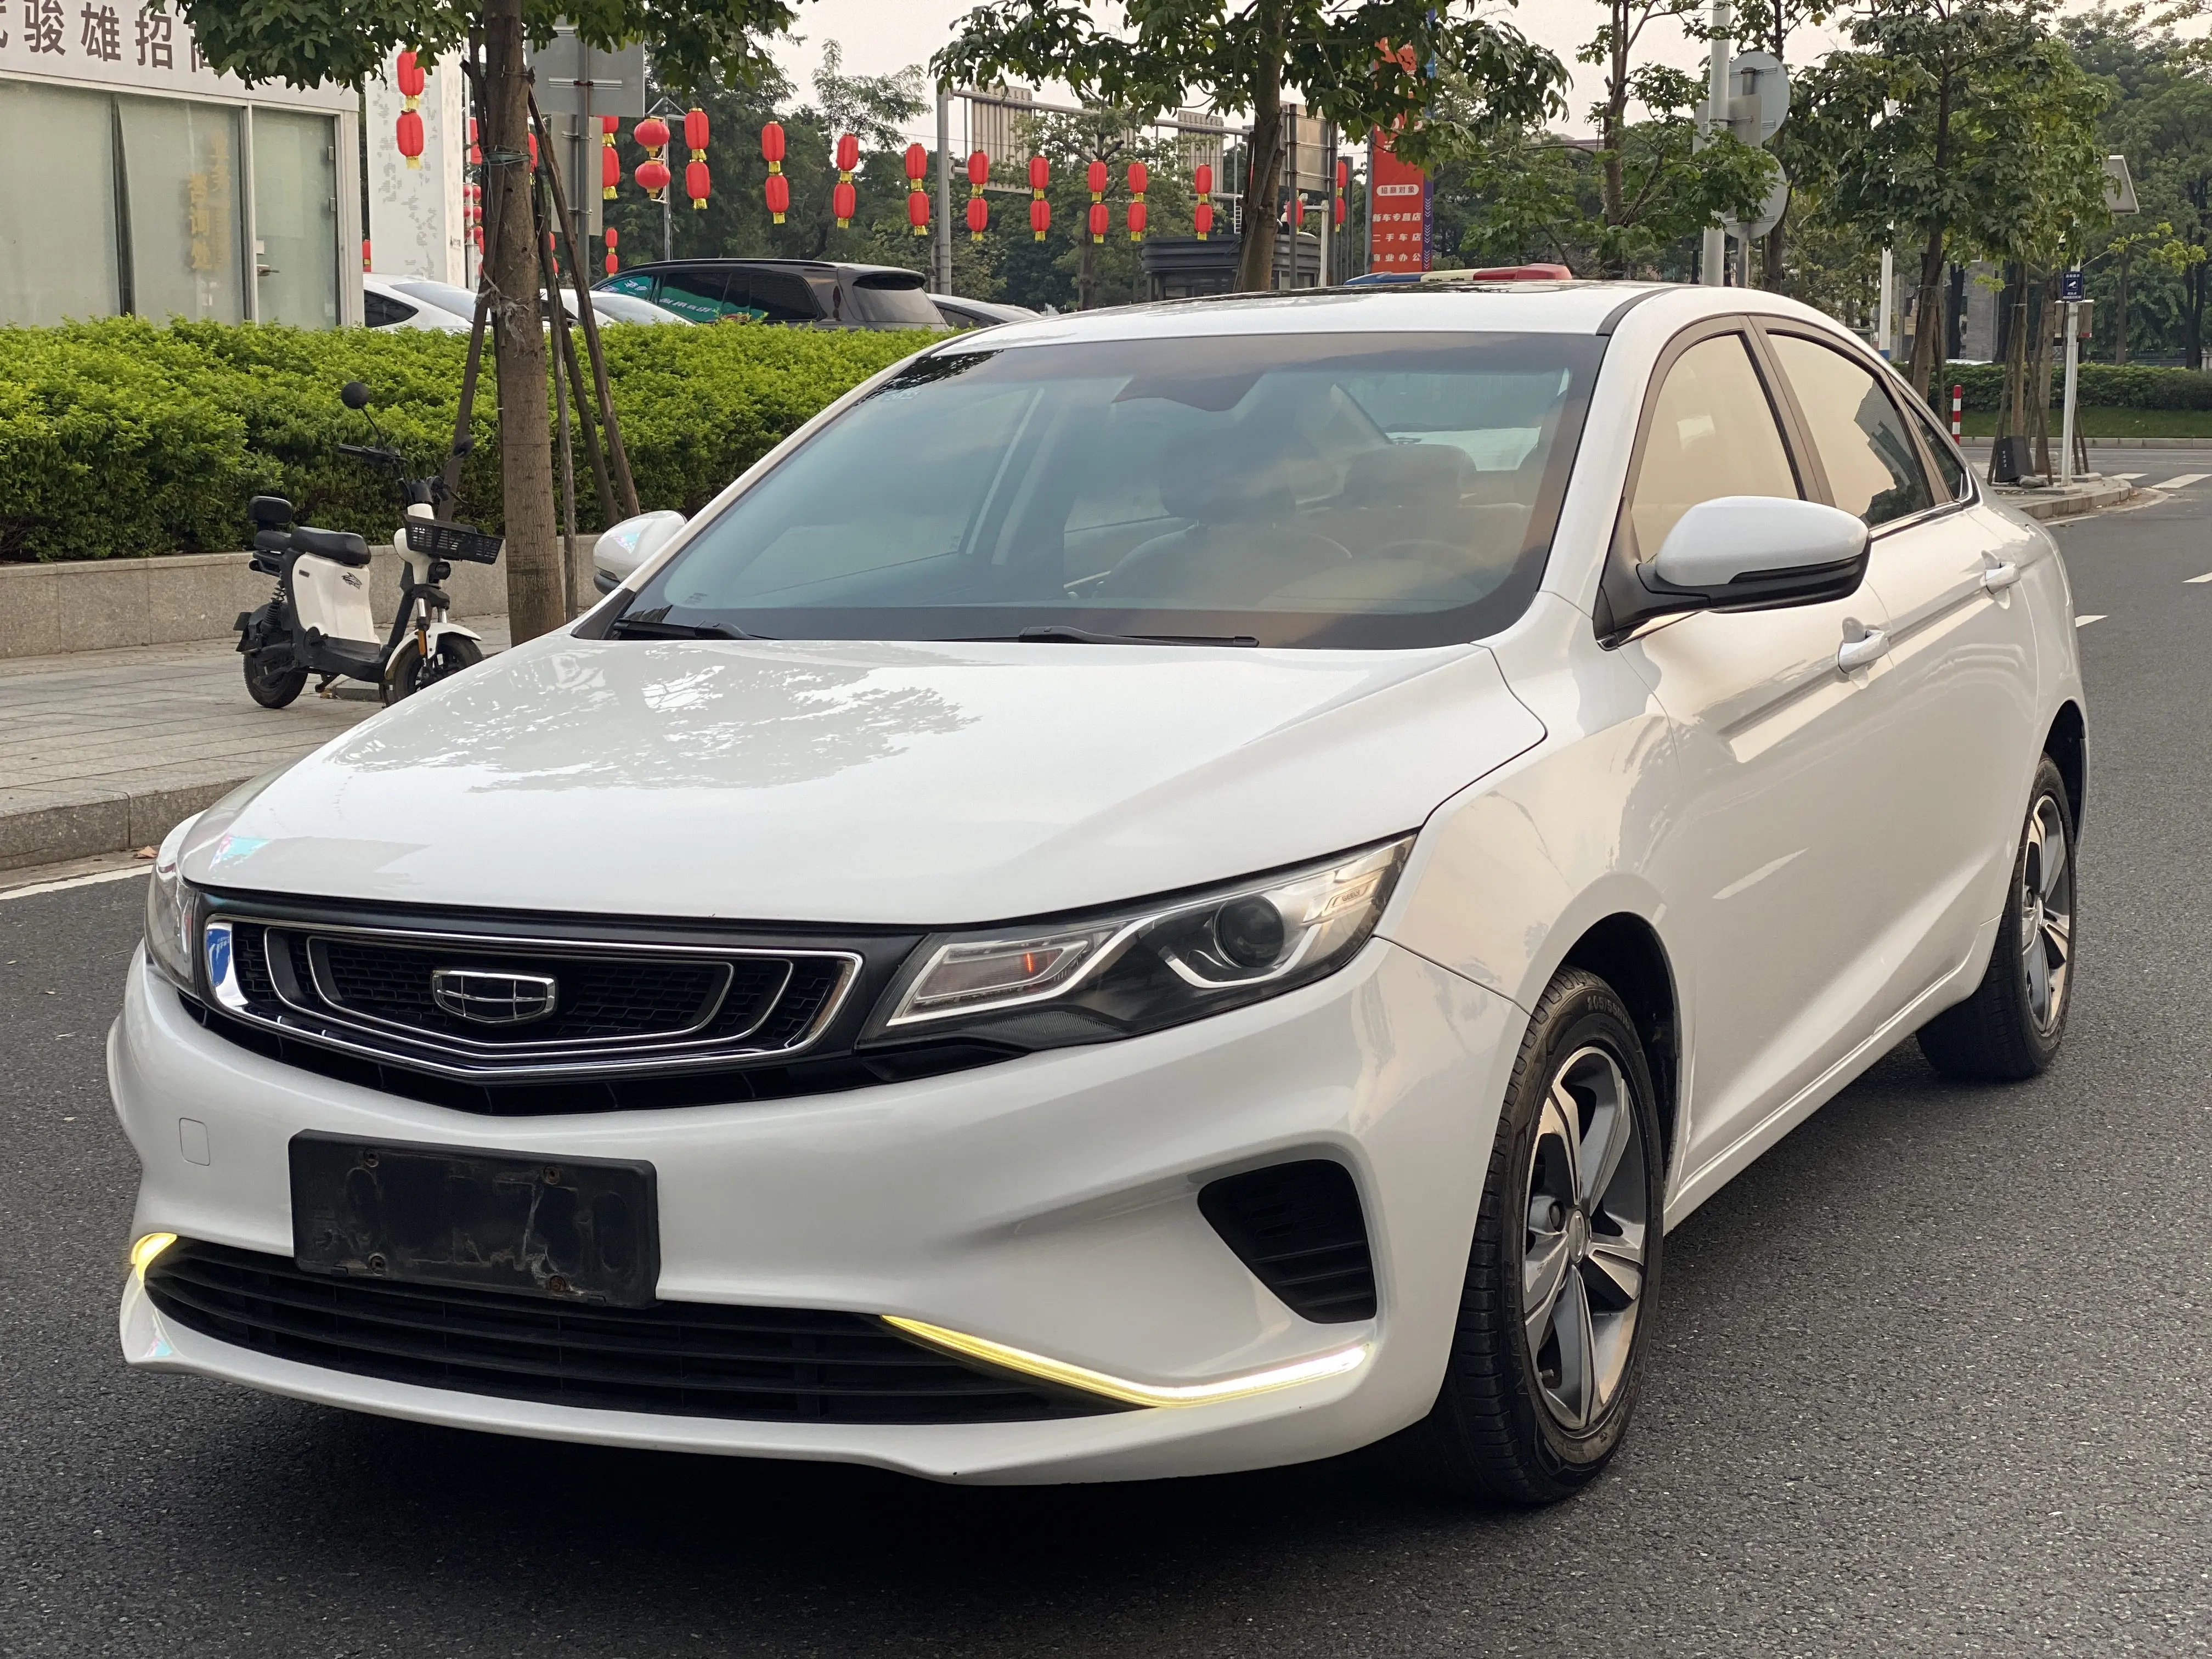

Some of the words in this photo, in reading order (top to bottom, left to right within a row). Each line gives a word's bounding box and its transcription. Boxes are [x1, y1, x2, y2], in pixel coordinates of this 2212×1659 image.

[0, 0, 216, 73] 骏雄招
[1381, 185, 1415, 194] 招商对象
[1372, 212, 1421, 222] 新车专营店
[1372, 233, 1421, 242] 二手车店
[1373, 252, 1421, 262] 商业办公
[1342, 890, 1361, 901] GEELY
